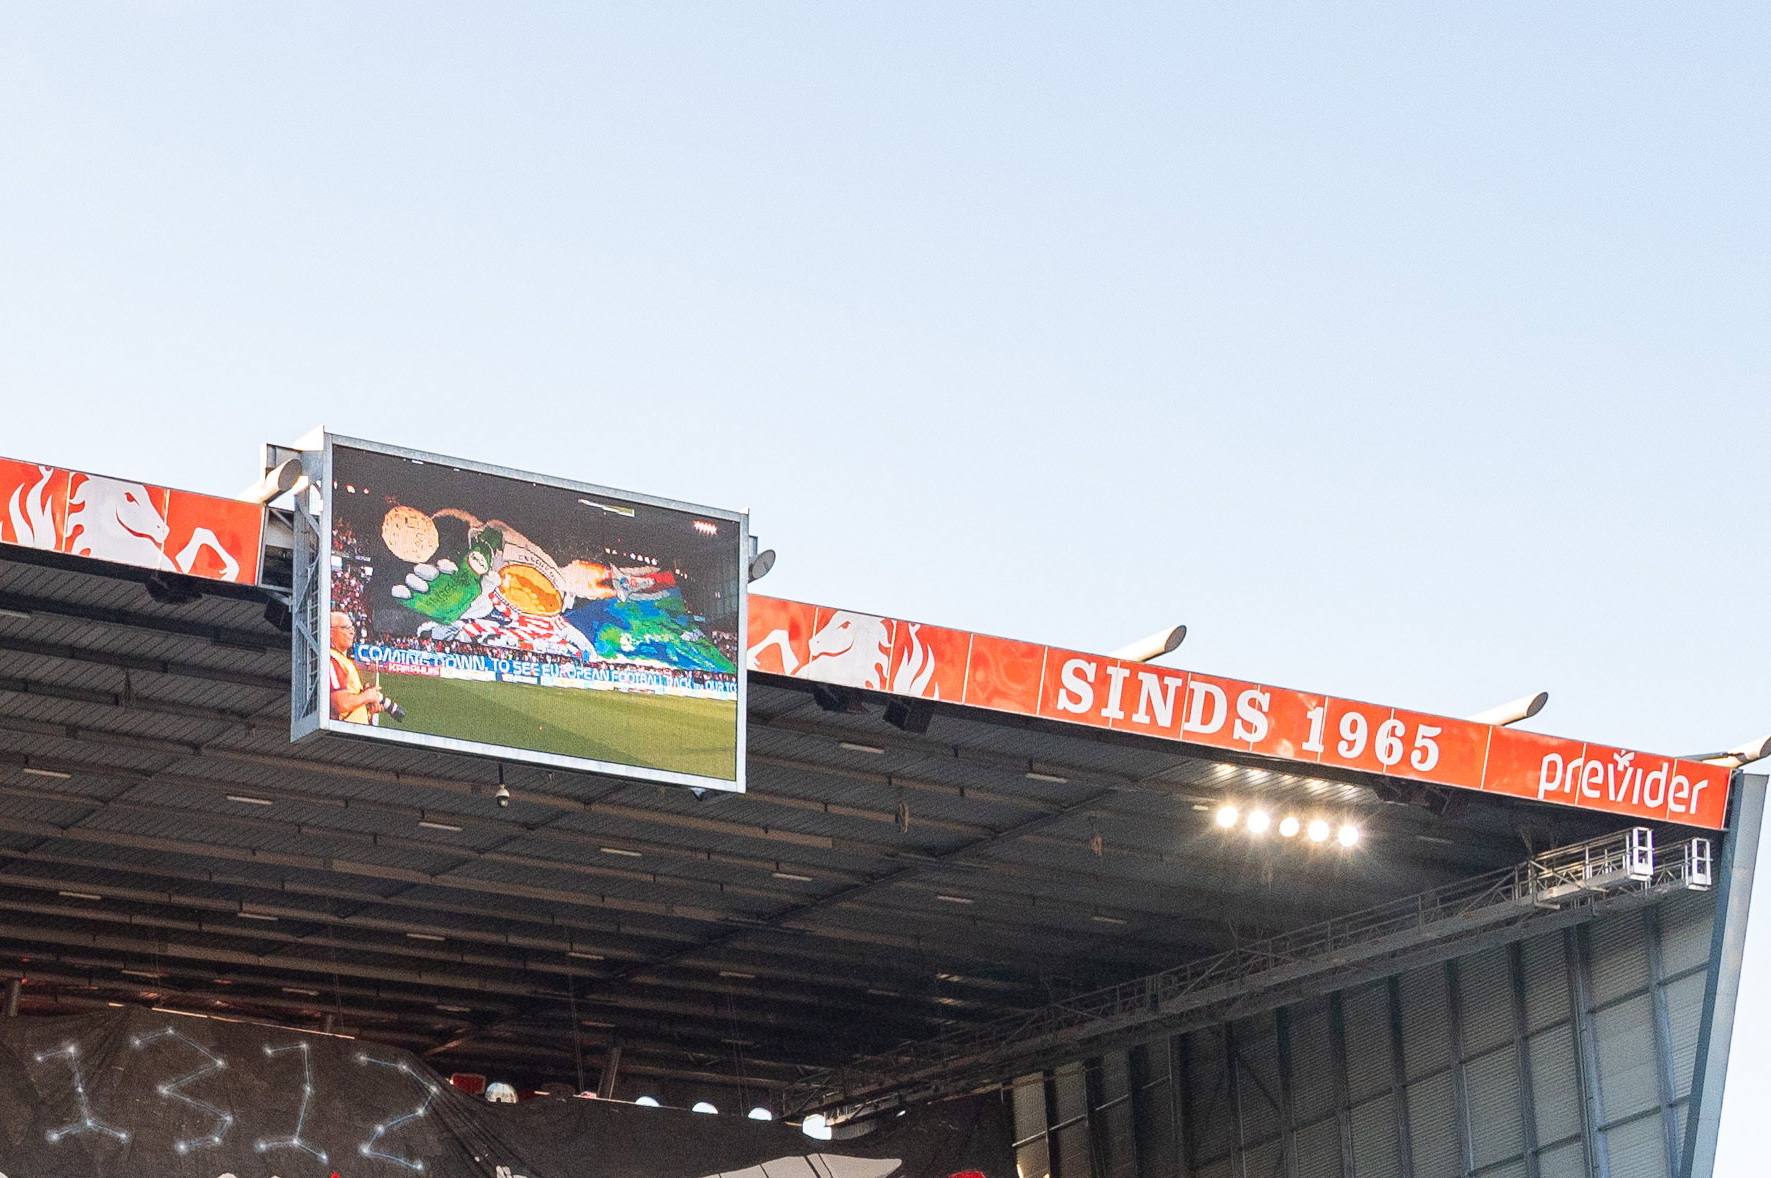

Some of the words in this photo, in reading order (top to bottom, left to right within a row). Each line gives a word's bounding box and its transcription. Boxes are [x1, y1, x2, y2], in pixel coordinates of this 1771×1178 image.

[492, 658, 510, 673] TO
[512, 661, 539, 677] SEE
[1056, 659, 1272, 743] SINDS
[1300, 706, 1442, 772] 1965
[1537, 748, 1709, 815] previder
